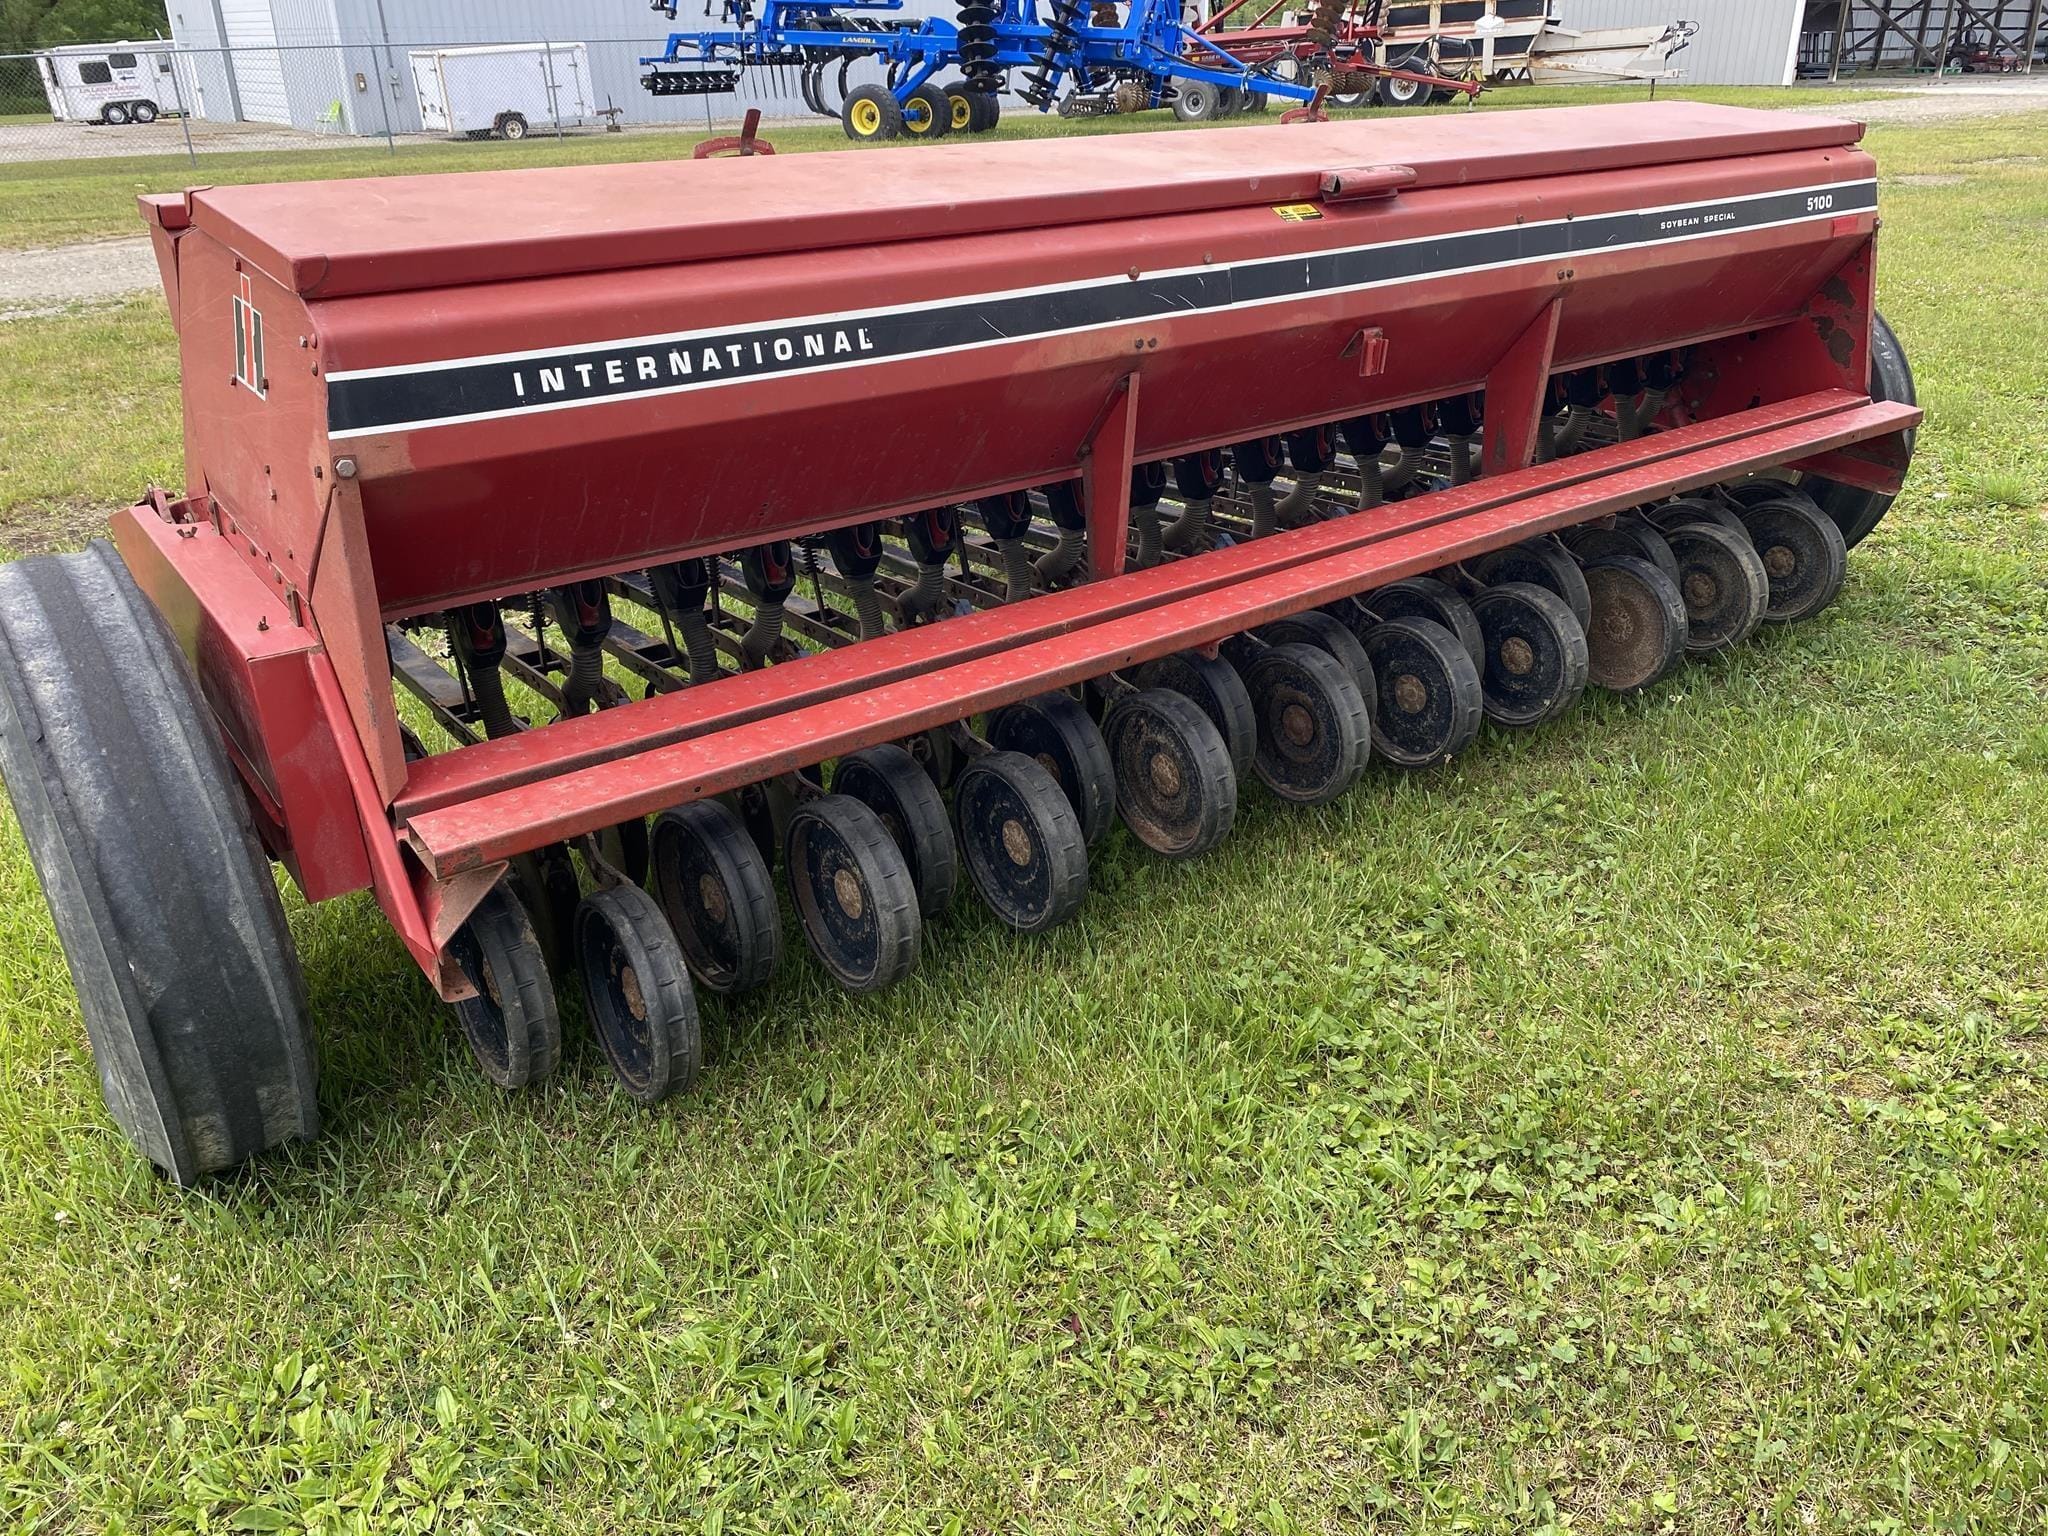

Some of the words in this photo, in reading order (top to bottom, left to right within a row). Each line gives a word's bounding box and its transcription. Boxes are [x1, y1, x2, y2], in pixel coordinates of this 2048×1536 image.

[1807, 195, 1833, 211] 5100
[1660, 217, 1700, 230] SOYBEAN
[1703, 212, 1736, 224] SPECIAL
[513, 328, 874, 396] INTERNATIONAL
